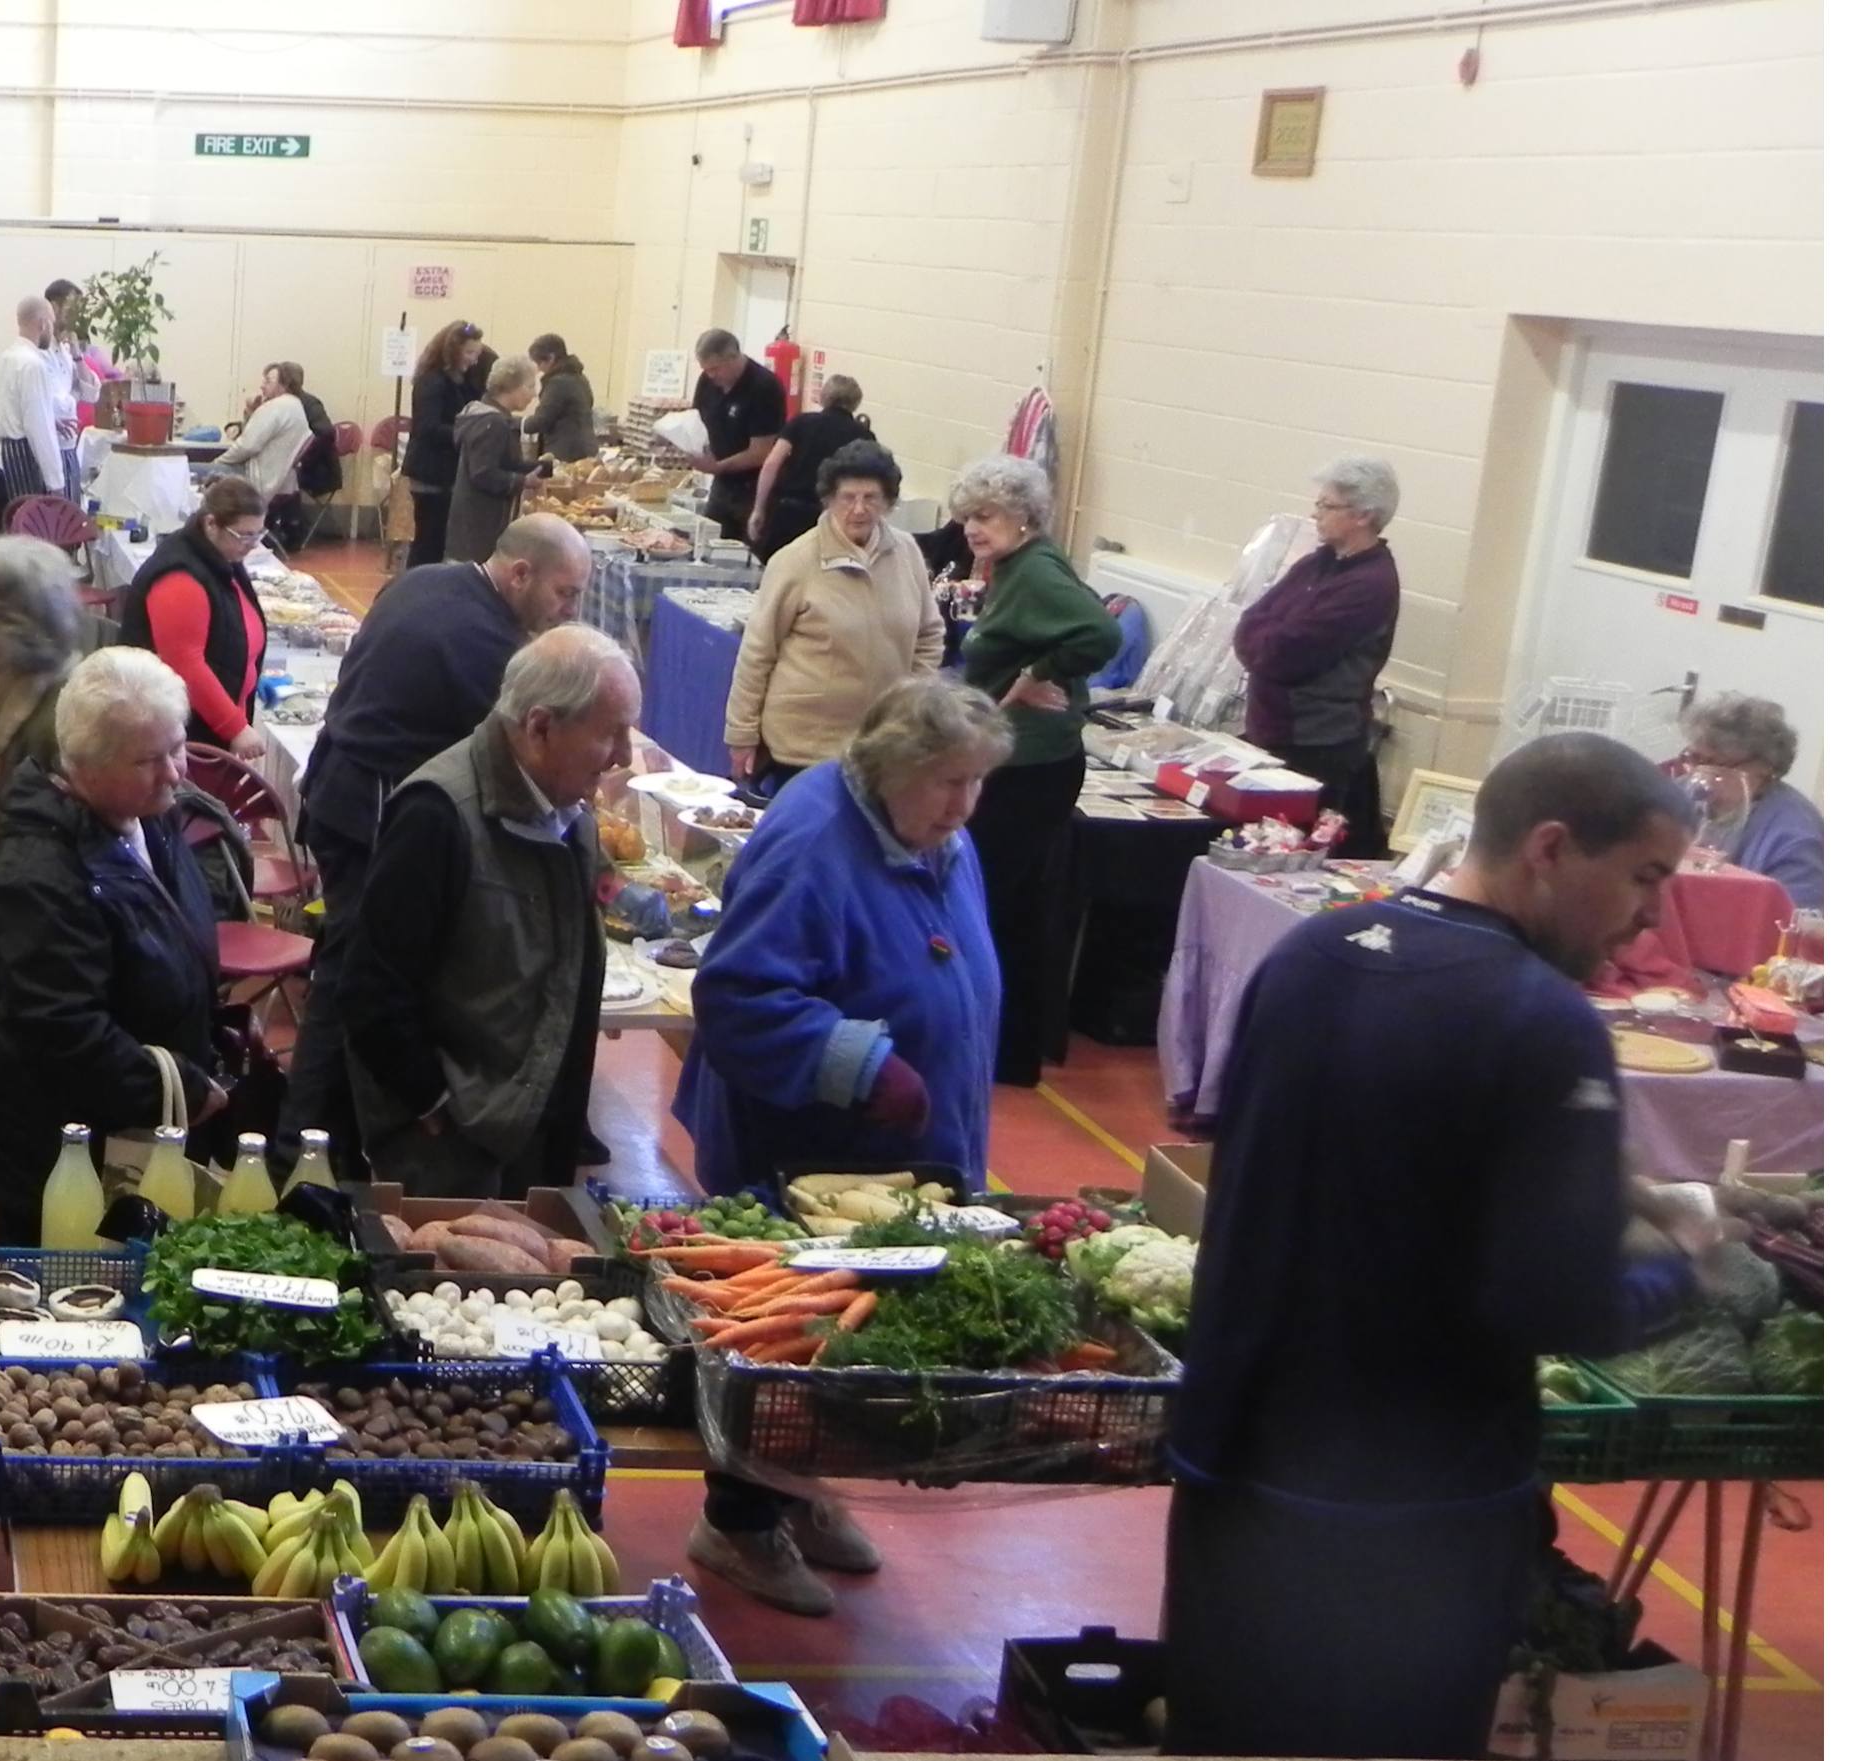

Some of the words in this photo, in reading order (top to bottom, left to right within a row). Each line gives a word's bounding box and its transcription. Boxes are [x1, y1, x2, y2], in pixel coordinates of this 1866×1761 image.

[204, 136, 236, 153] FIRE
[242, 136, 277, 155] EXIT
[414, 286, 448, 297] EGGS
